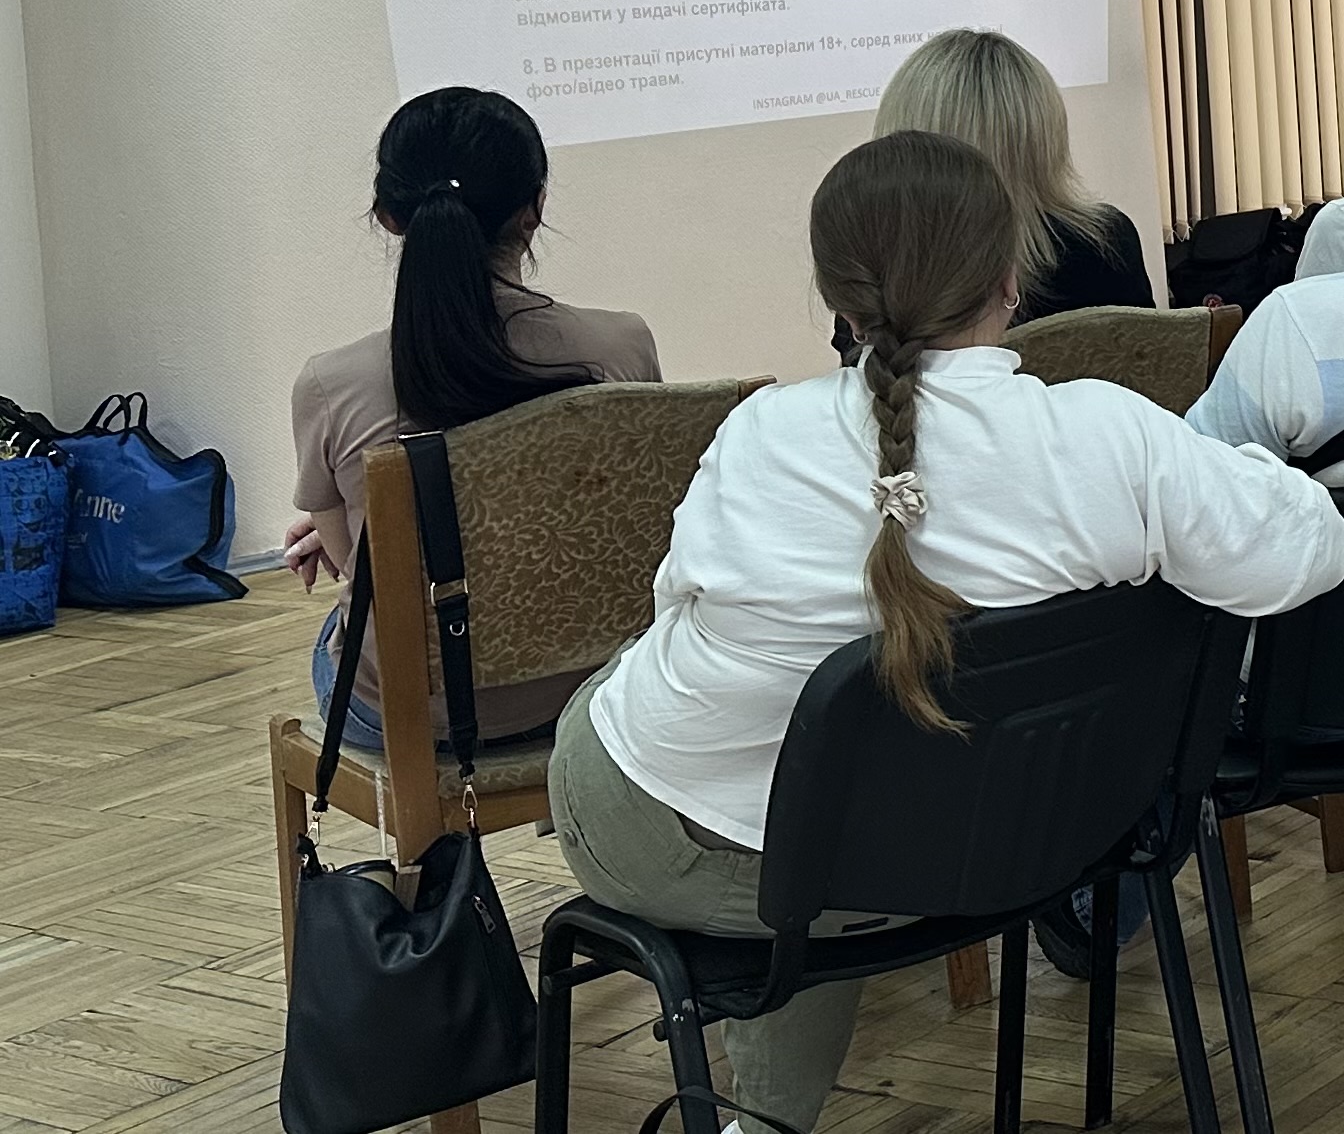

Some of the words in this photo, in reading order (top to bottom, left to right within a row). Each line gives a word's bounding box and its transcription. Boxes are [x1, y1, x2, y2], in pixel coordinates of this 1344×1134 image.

[517, 7, 612, 27] відмовити
[617, 8, 627, 24] у
[632, 1, 686, 20] видачі
[523, 58, 539, 75] 8.
[544, 57, 557, 73] В
[562, 49, 661, 72] презентації
[666, 43, 735, 65] присутні
[739, 38, 815, 58] матеріали
[851, 33, 890, 49] серед
[894, 31, 922, 45] яких
[526, 77, 625, 102] фото/відео
[630, 72, 684, 92] травм.
[752, 94, 813, 110] INSTAGRAM
